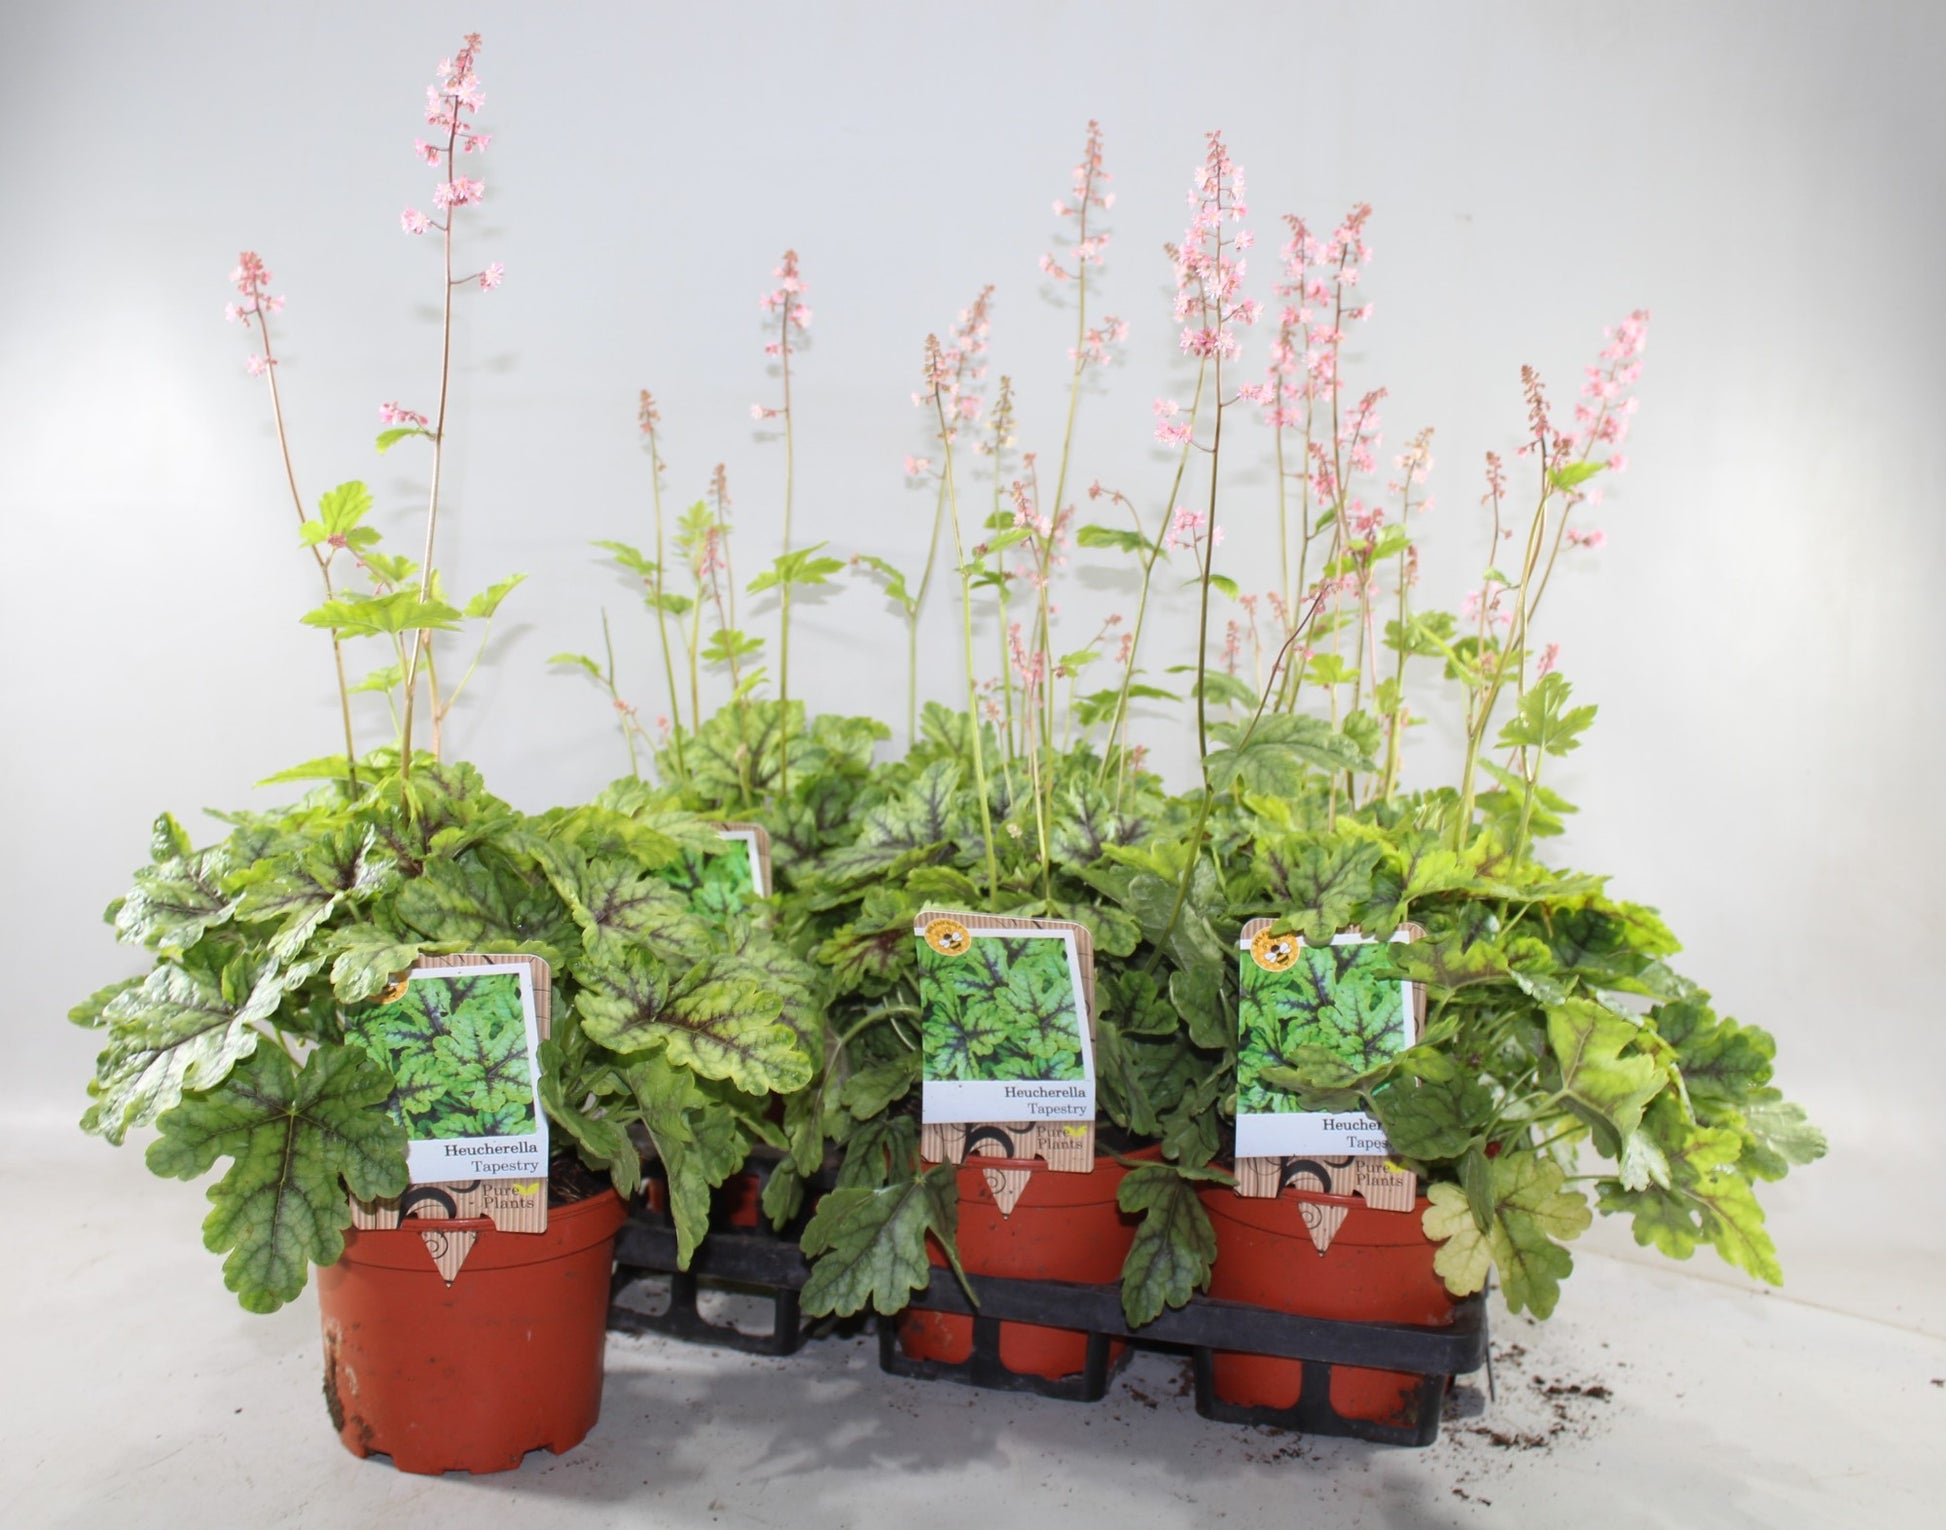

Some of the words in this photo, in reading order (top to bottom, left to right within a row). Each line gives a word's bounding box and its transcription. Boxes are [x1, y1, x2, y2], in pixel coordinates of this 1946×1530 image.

[1005, 1086, 1086, 1098] Heucherella
[1027, 1102, 1087, 1117] Tapestry
[1037, 1126, 1070, 1138] Pure
[444, 1141, 538, 1156] Heucherella
[1038, 1138, 1083, 1150] Plants
[1346, 1136, 1391, 1151] Tapes
[471, 1160, 539, 1174] Tapestry
[1356, 1161, 1391, 1174] Pure
[1356, 1174, 1404, 1187] Plants
[483, 1184, 520, 1196] Pure
[484, 1196, 535, 1209] Plants
